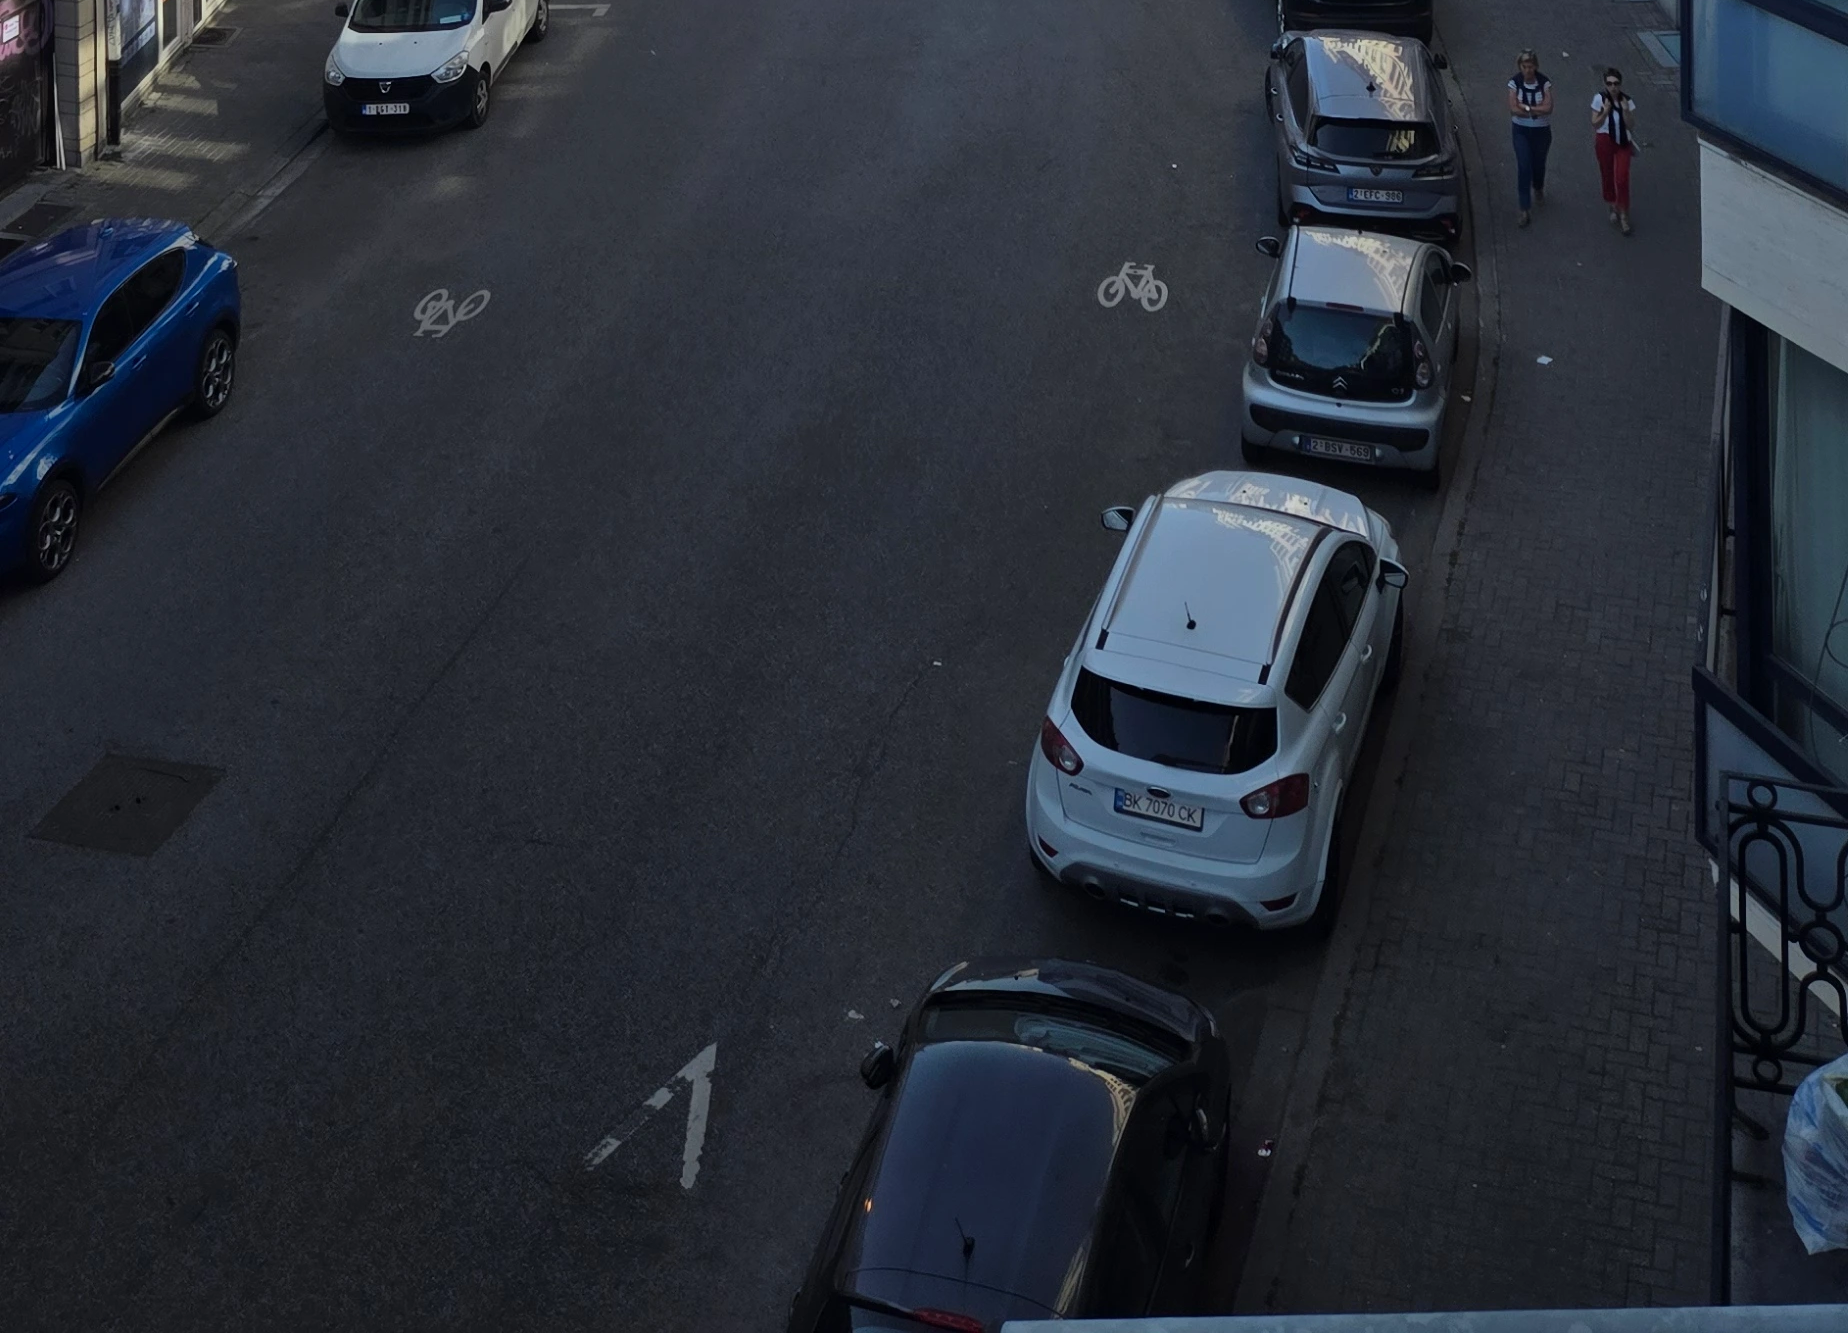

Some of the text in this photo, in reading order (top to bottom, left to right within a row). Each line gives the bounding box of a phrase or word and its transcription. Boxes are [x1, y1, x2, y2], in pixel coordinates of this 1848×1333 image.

[1123, 793, 1196, 824] BK 7070 CK
